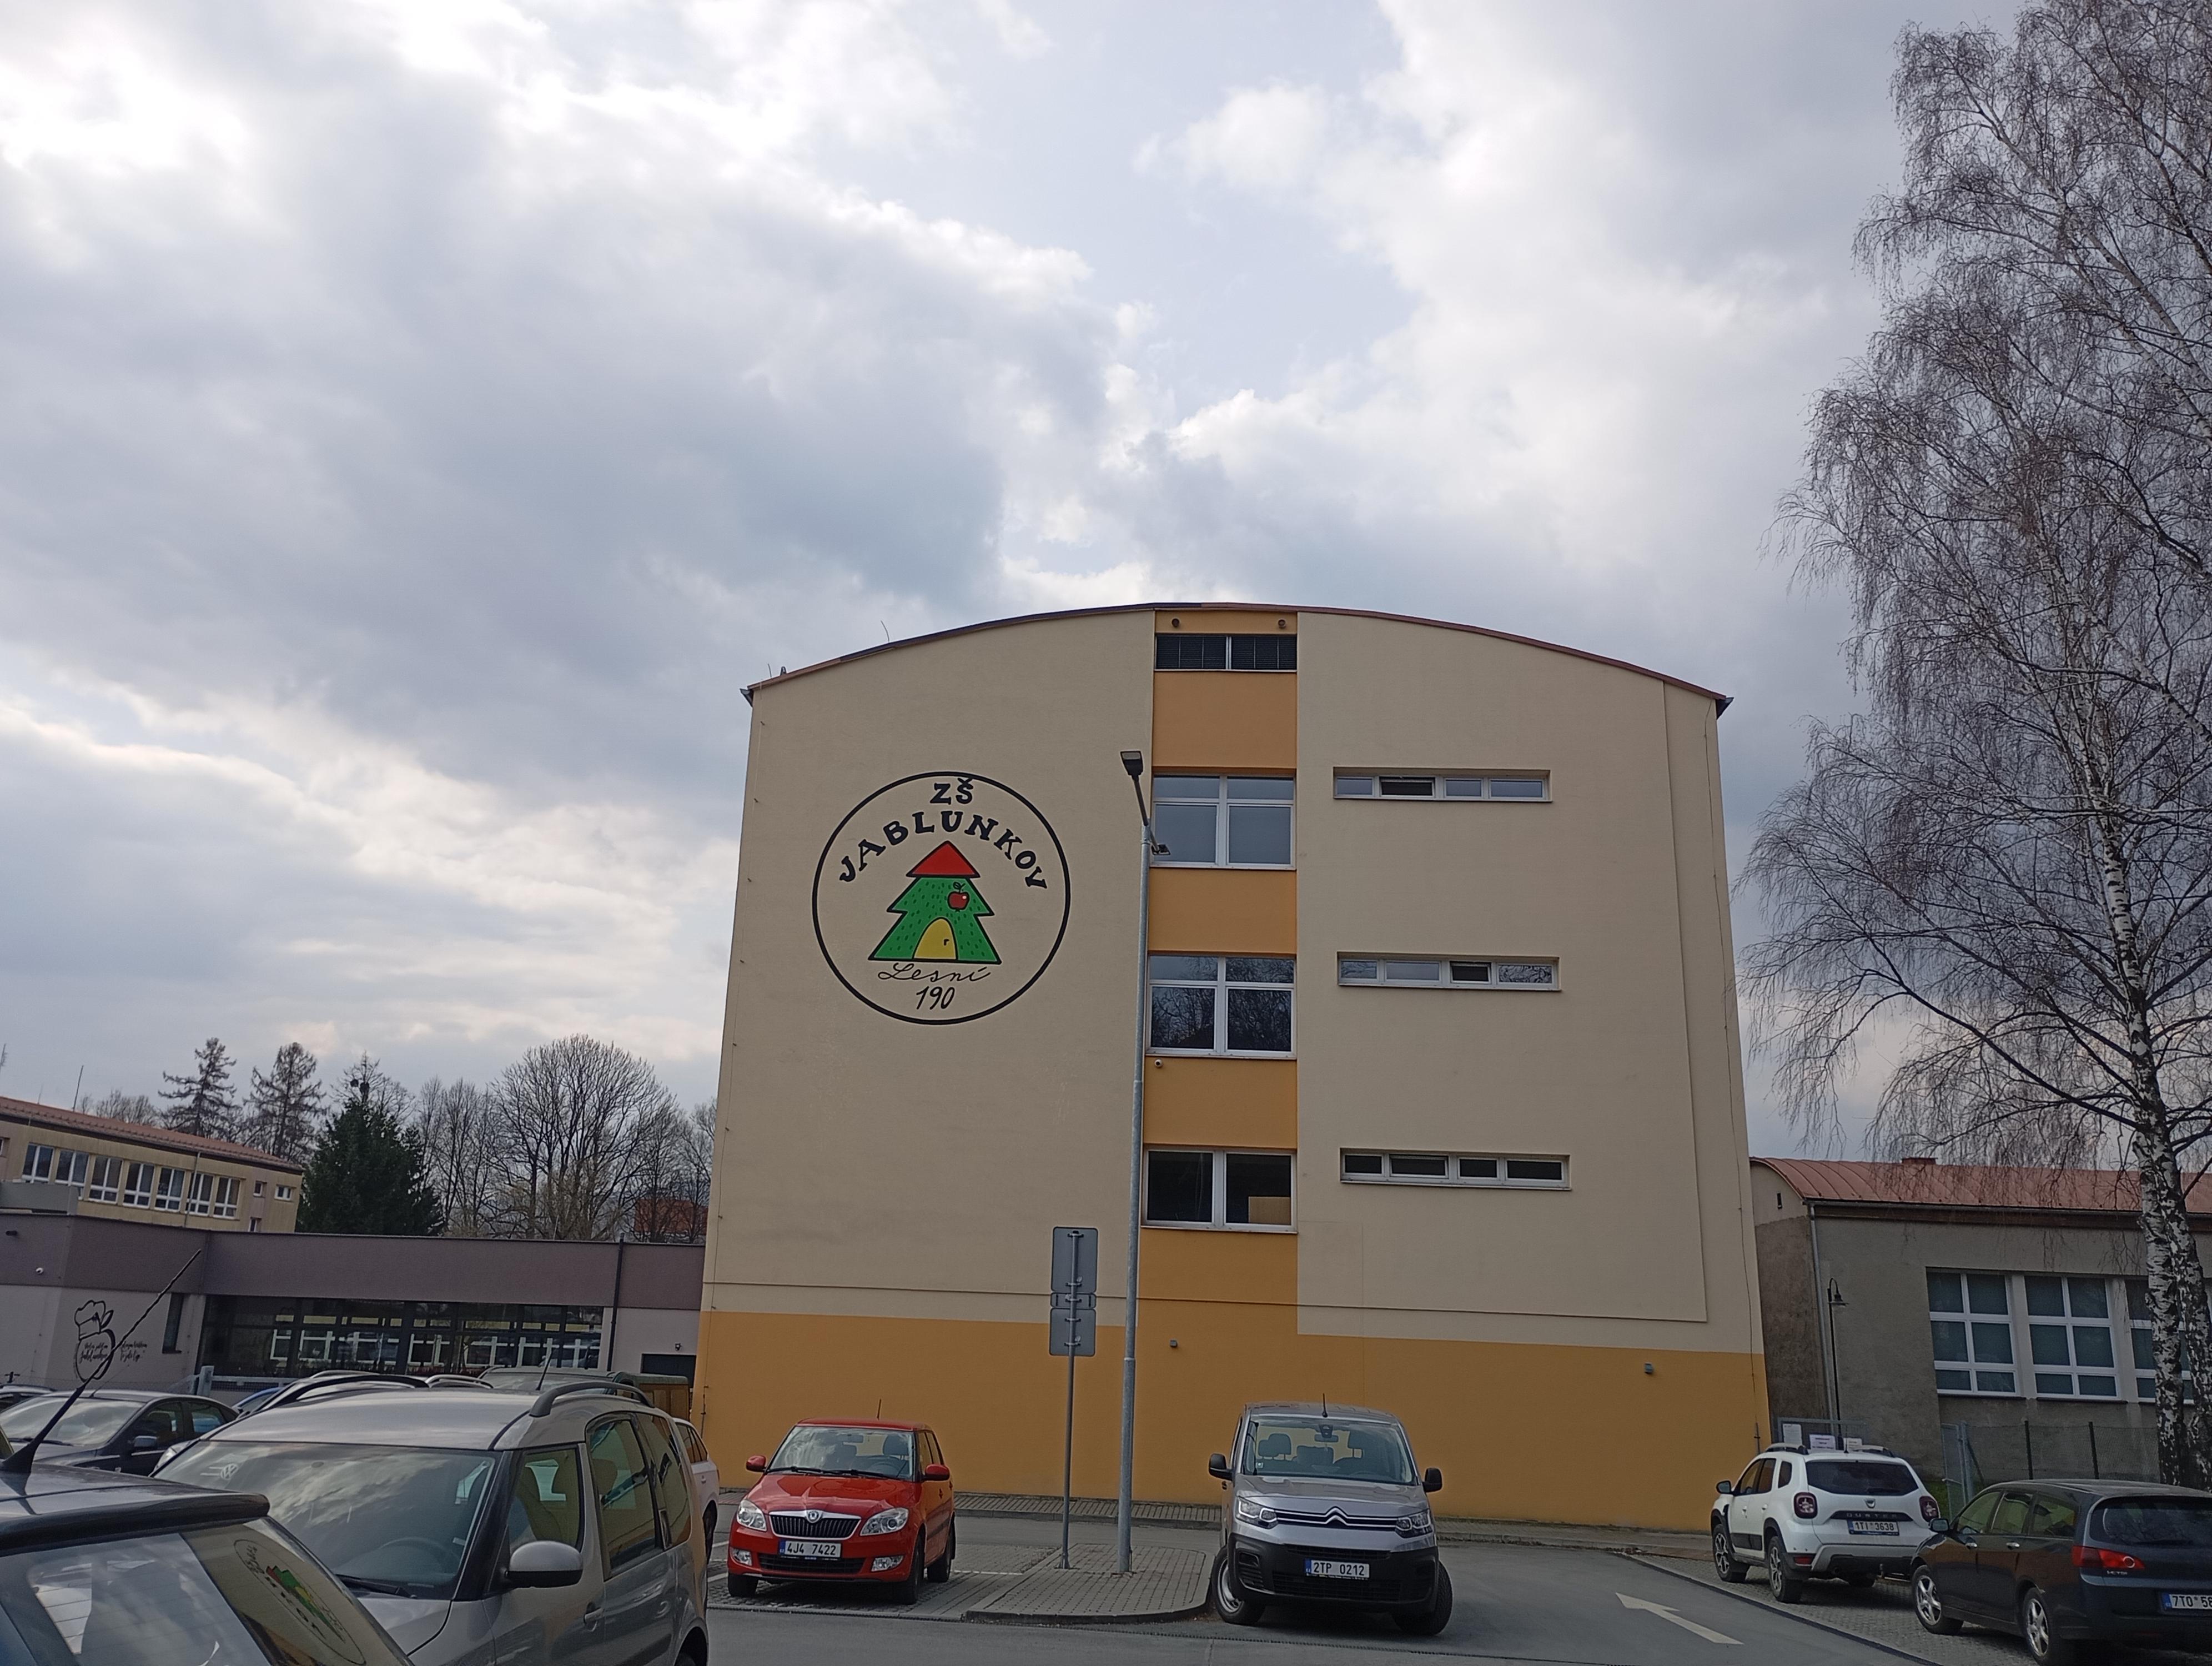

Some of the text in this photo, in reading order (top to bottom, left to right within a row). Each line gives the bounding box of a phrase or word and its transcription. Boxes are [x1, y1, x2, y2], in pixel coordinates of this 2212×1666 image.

[929, 777, 974, 805] ZŠ
[838, 810, 1048, 889] JABLUNKOV
[877, 962, 992, 983] Lesní
[916, 986, 956, 1010] 190
[787, 1542, 837, 1555] 4J4 7422
[1313, 1562, 1365, 1577] 2TP 0212
